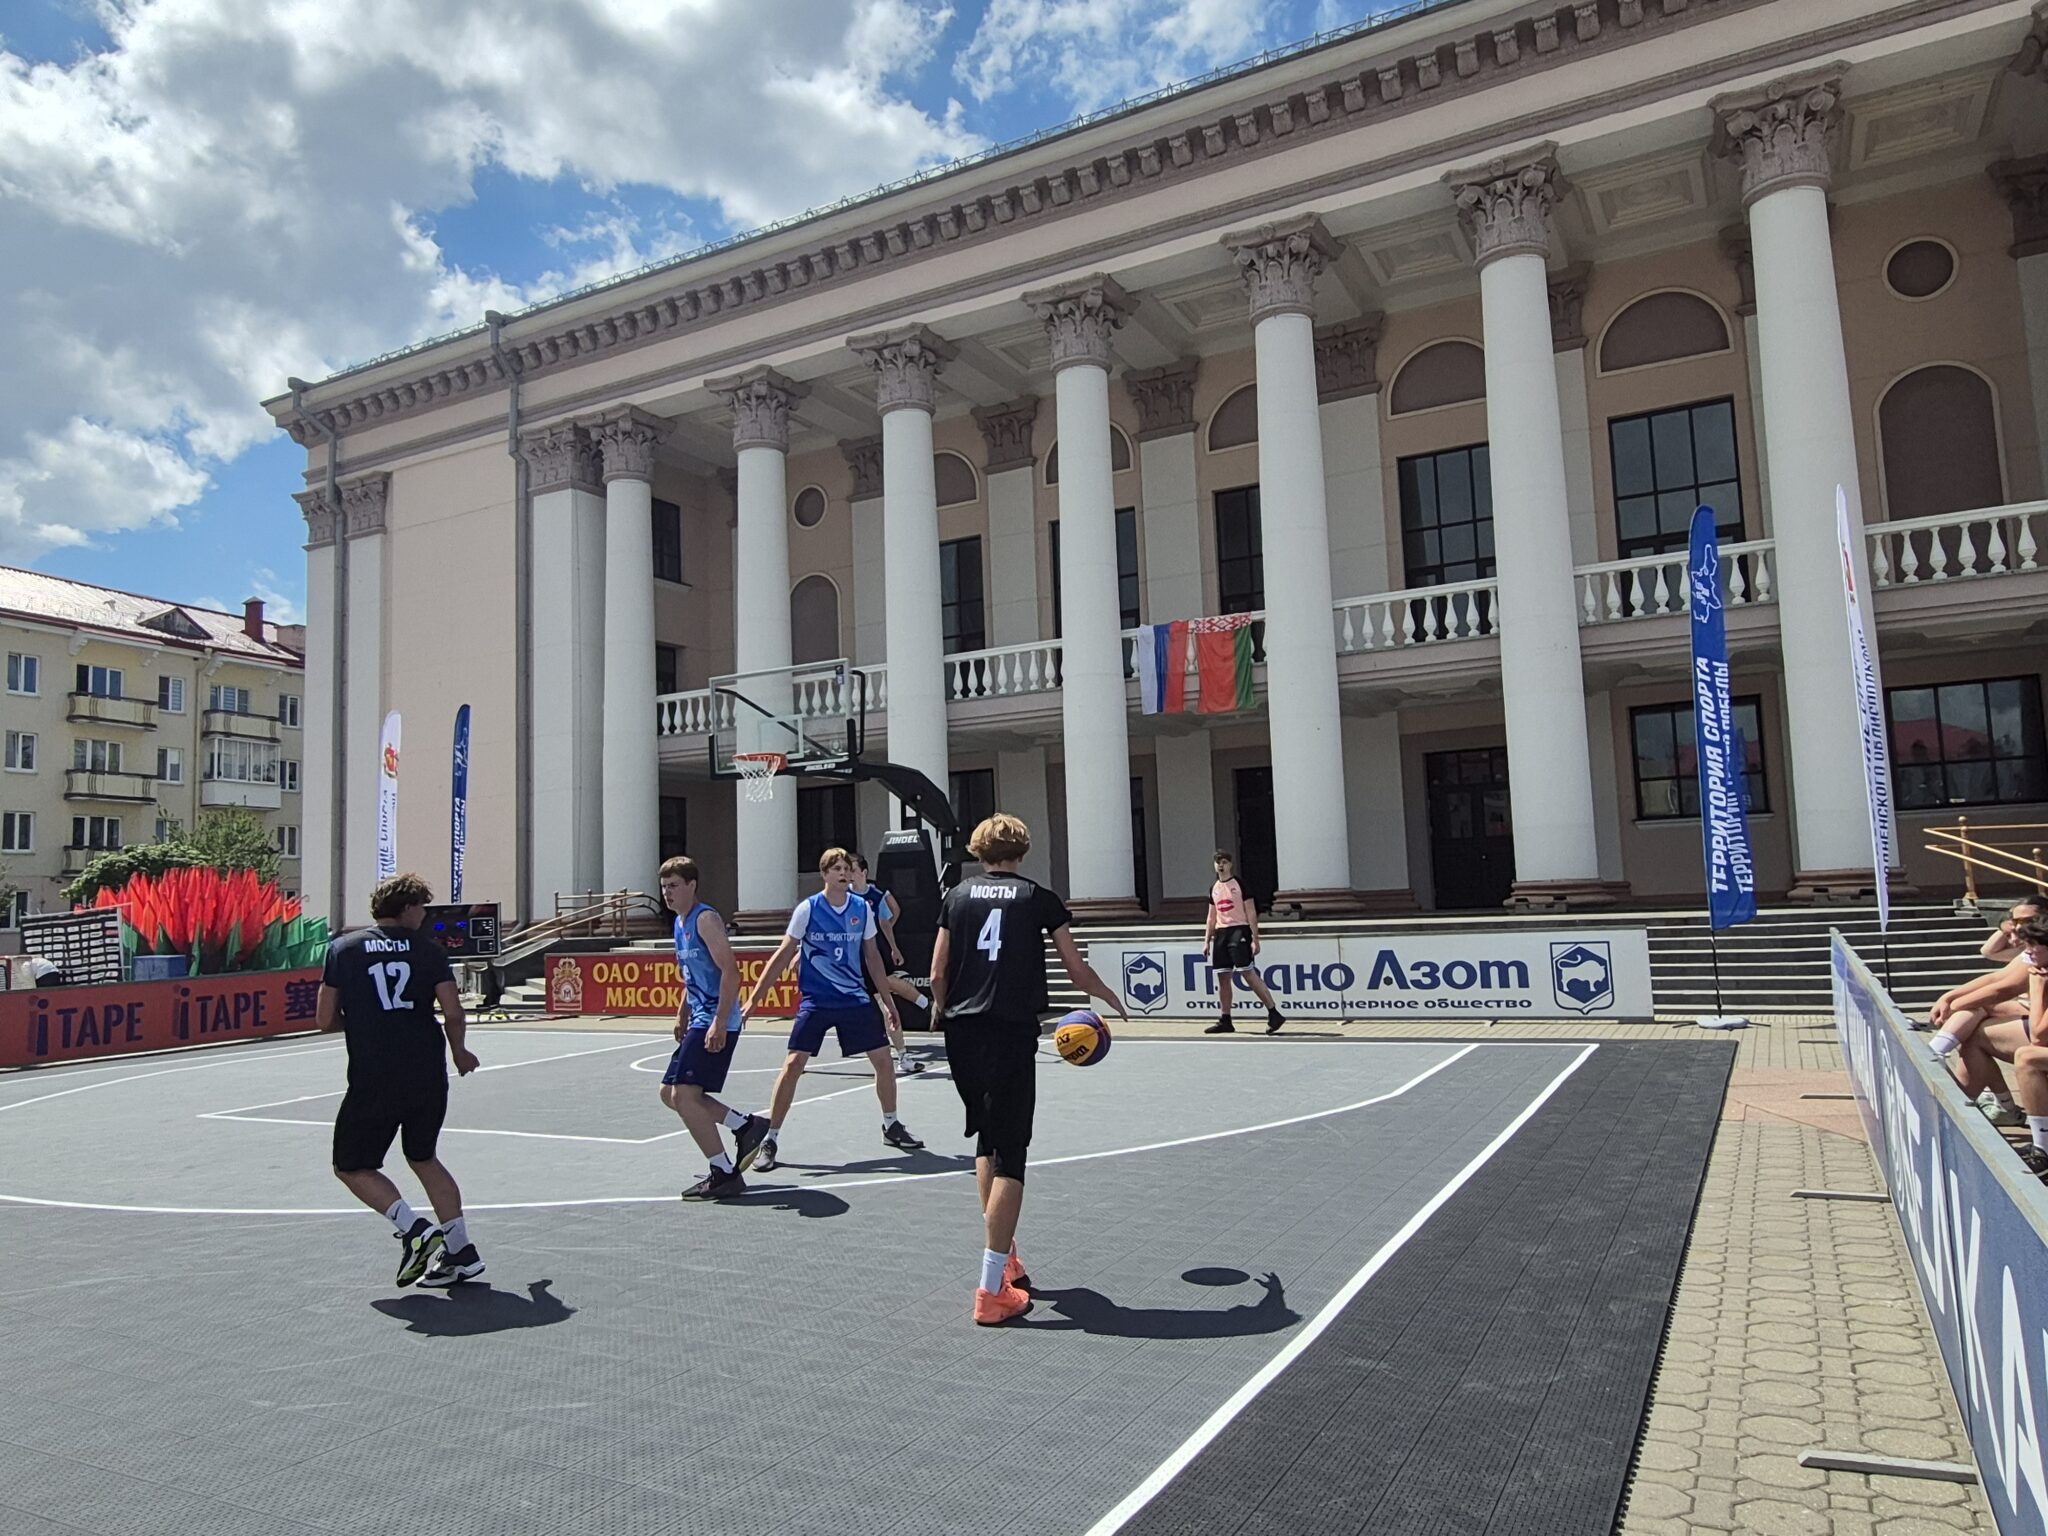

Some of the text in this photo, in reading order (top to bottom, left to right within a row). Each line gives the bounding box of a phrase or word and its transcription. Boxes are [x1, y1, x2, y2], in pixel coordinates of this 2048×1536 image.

[1696, 656, 1729, 894] ТЕРРИТОРИЯ СПОРТА
[970, 884, 1017, 899] МОСТЫ
[976, 908, 1002, 961] 4
[834, 947, 843, 961] 9
[593, 962, 639, 983] ОАО
[1367, 950, 1530, 990] Азот
[368, 961, 414, 1010] 12
[1424, 998, 1532, 1009] общество
